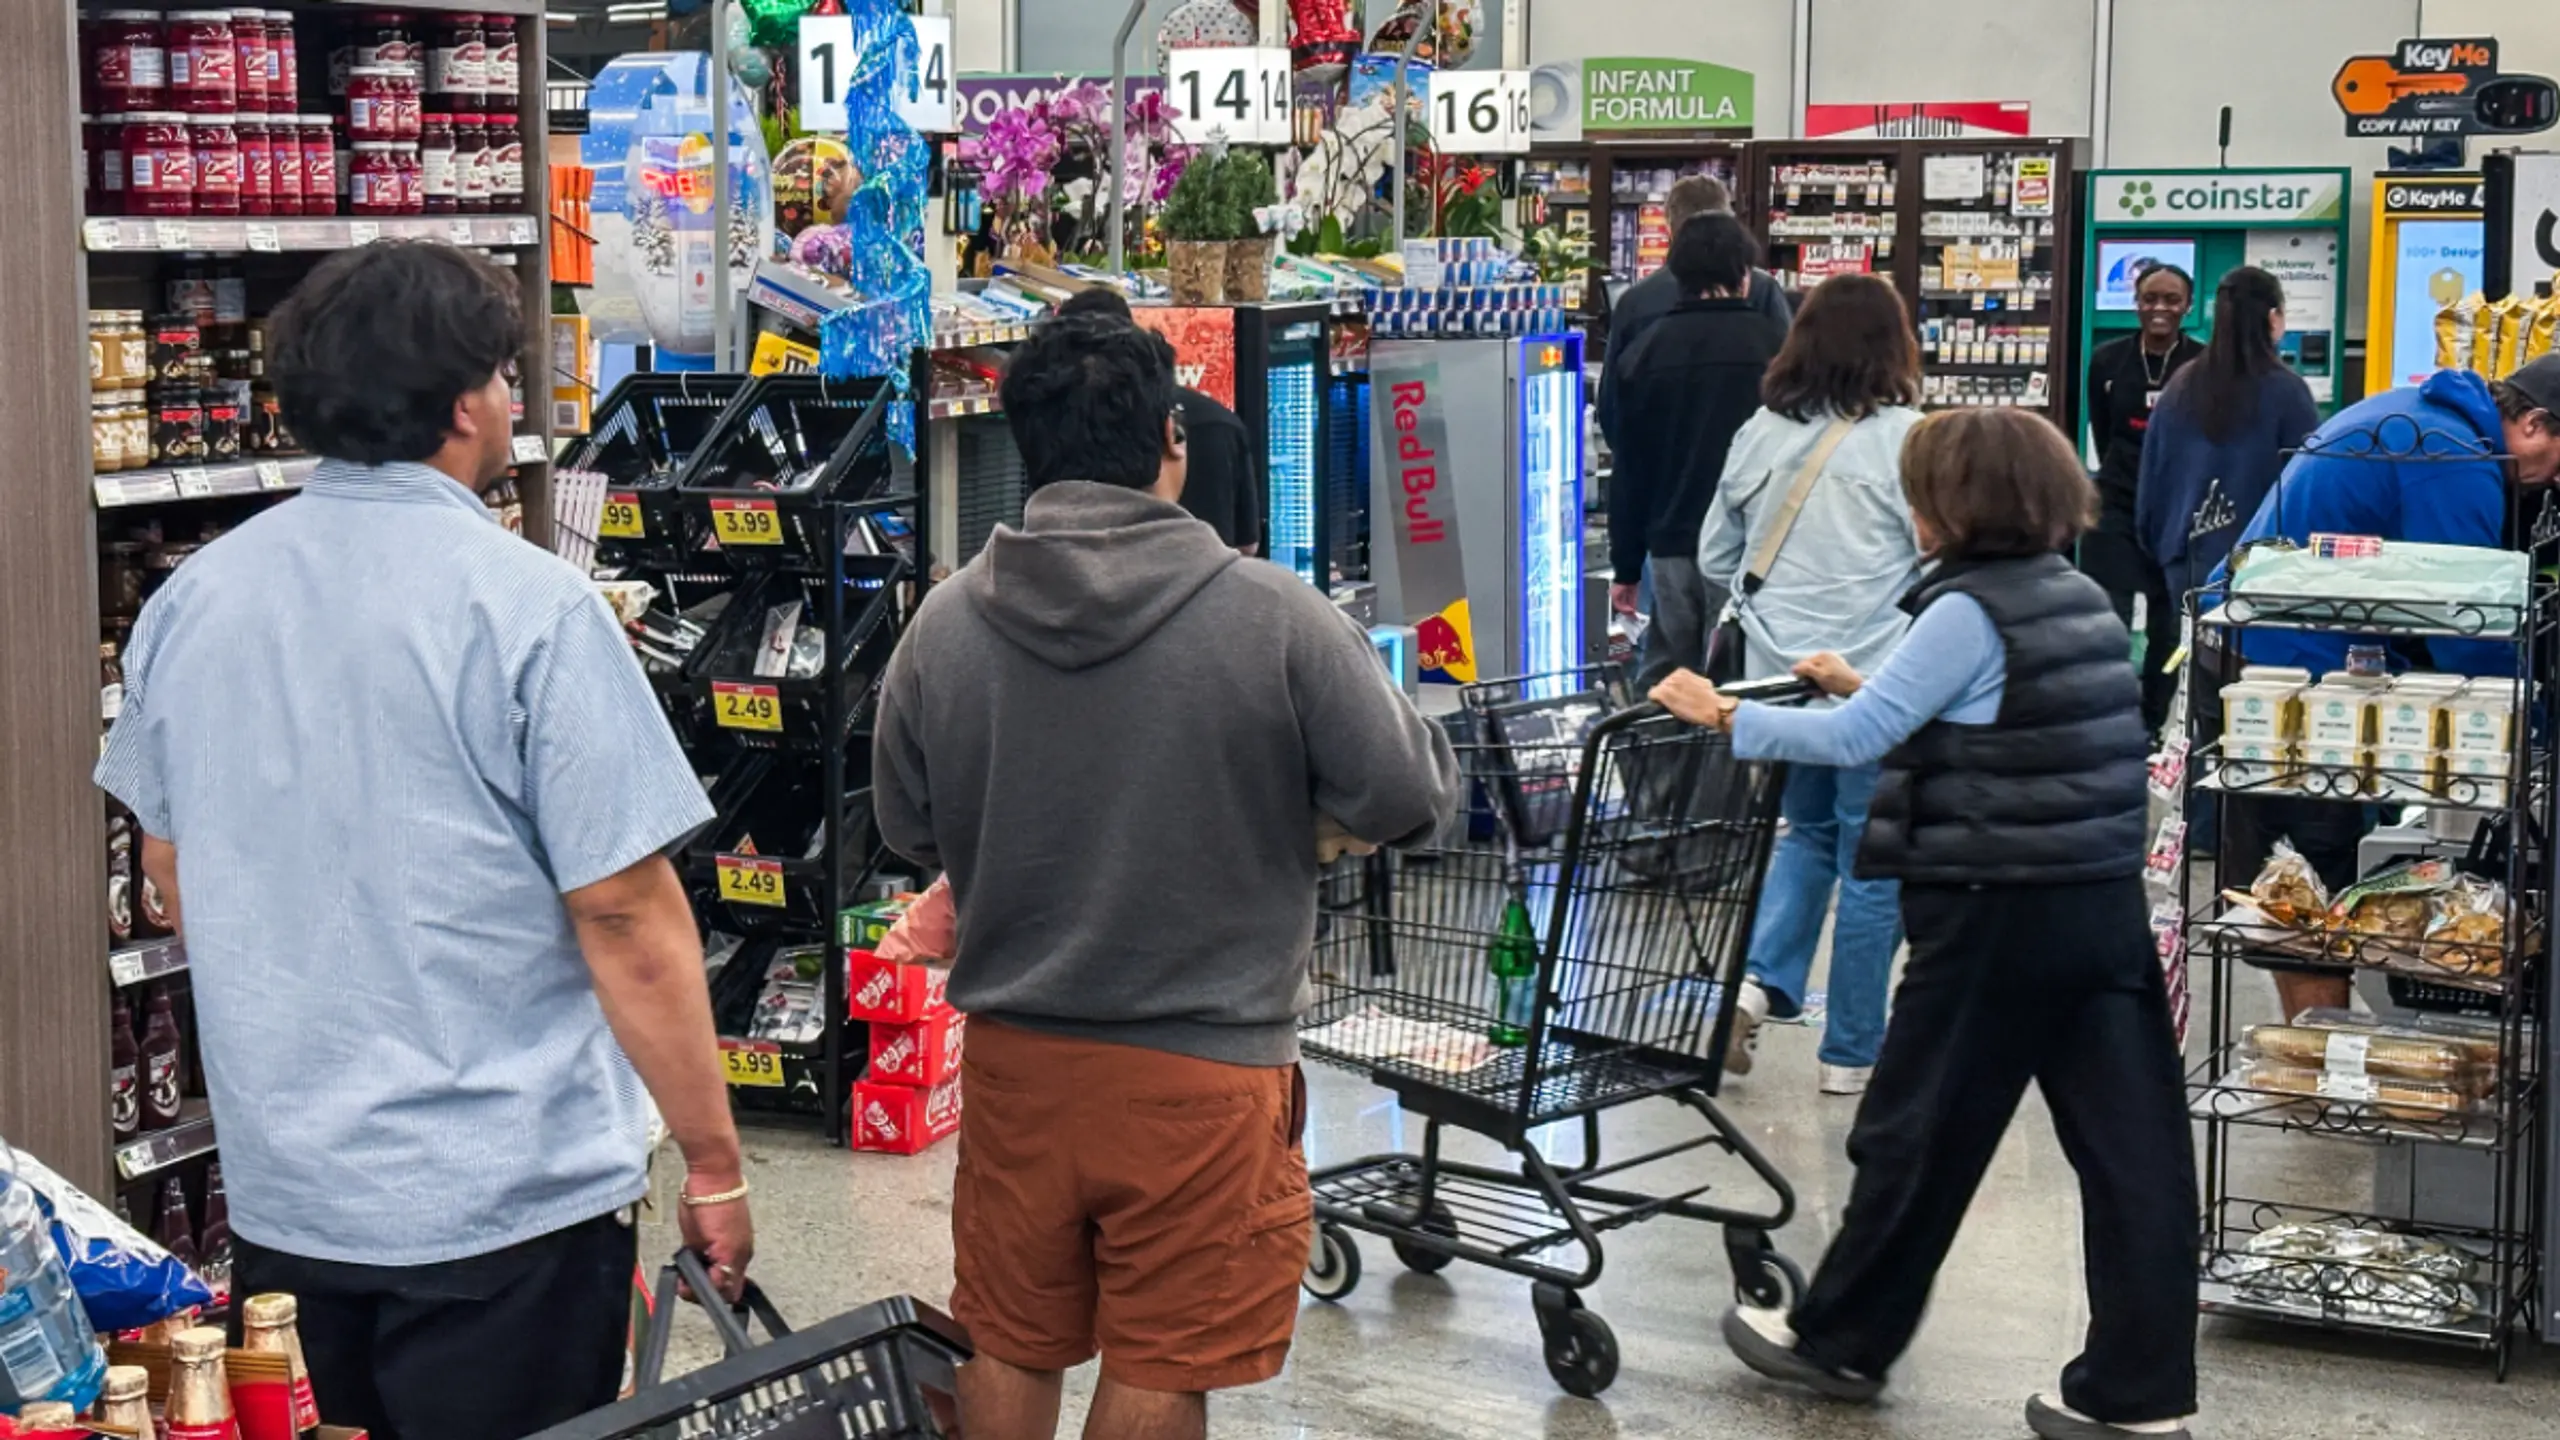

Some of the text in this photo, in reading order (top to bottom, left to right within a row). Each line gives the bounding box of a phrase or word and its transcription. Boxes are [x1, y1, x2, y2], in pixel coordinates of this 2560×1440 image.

[2404, 43, 2490, 71] KeyMe
[1589, 68, 1696, 94] INFANT
[1179, 68, 1251, 120] 14
[1260, 68, 1288, 121] 14
[1437, 88, 1500, 133] 16
[1508, 87, 1529, 133] 16
[1589, 96, 1737, 121] FORMULA
[2357, 117, 2462, 133] COPY ANY KEY
[2166, 180, 2311, 210] coinstar
[2408, 189, 2466, 209] KeyMe
[1390, 380, 1446, 544] Red Bull
[602, 504, 634, 526] .99
[723, 511, 772, 534] 3.99
[725, 694, 773, 719] 2.49
[730, 868, 776, 893] 2.49
[727, 1051, 773, 1074] 5.99
